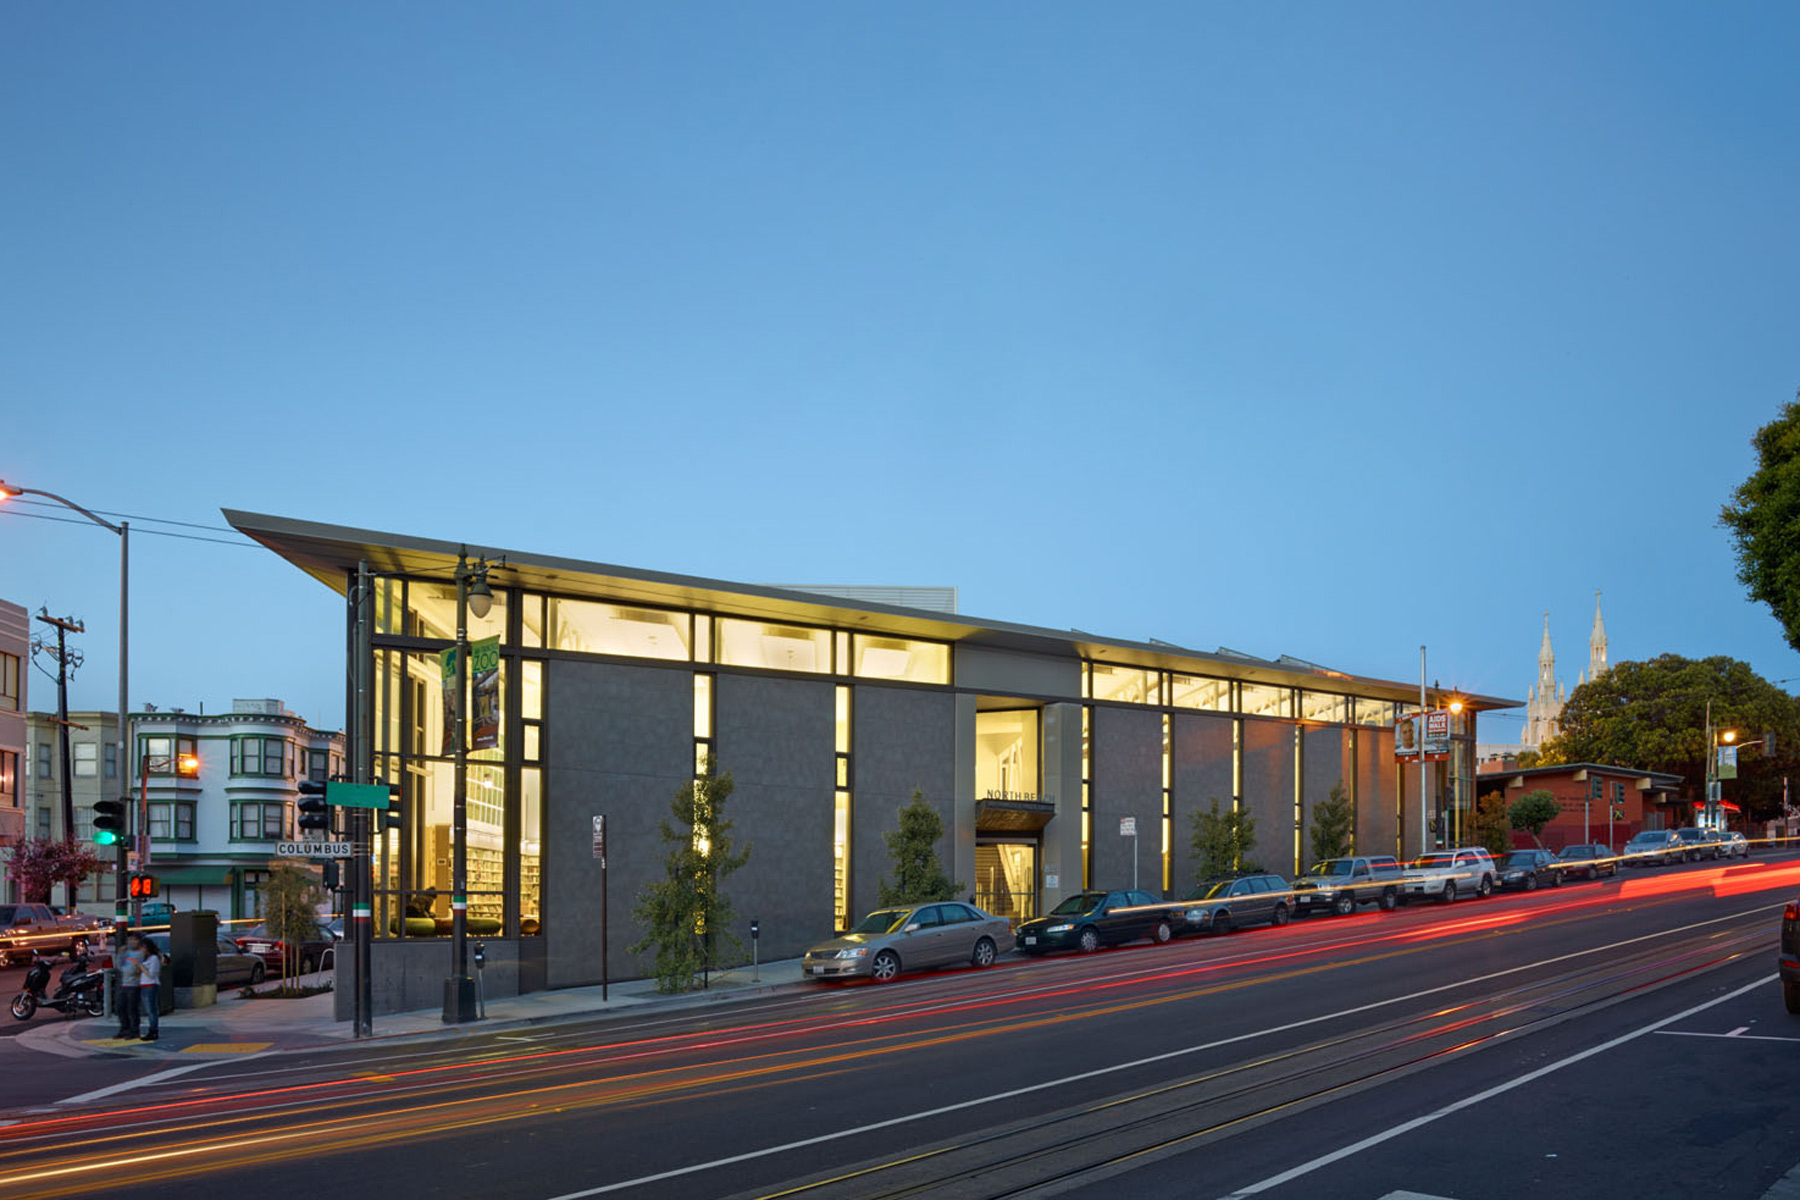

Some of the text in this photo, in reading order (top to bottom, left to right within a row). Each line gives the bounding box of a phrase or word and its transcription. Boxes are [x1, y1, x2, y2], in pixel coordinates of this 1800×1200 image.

[473, 650, 499, 671] ZOO
[987, 789, 1021, 800] NORTH
[278, 844, 349, 854] COLUMBUS
